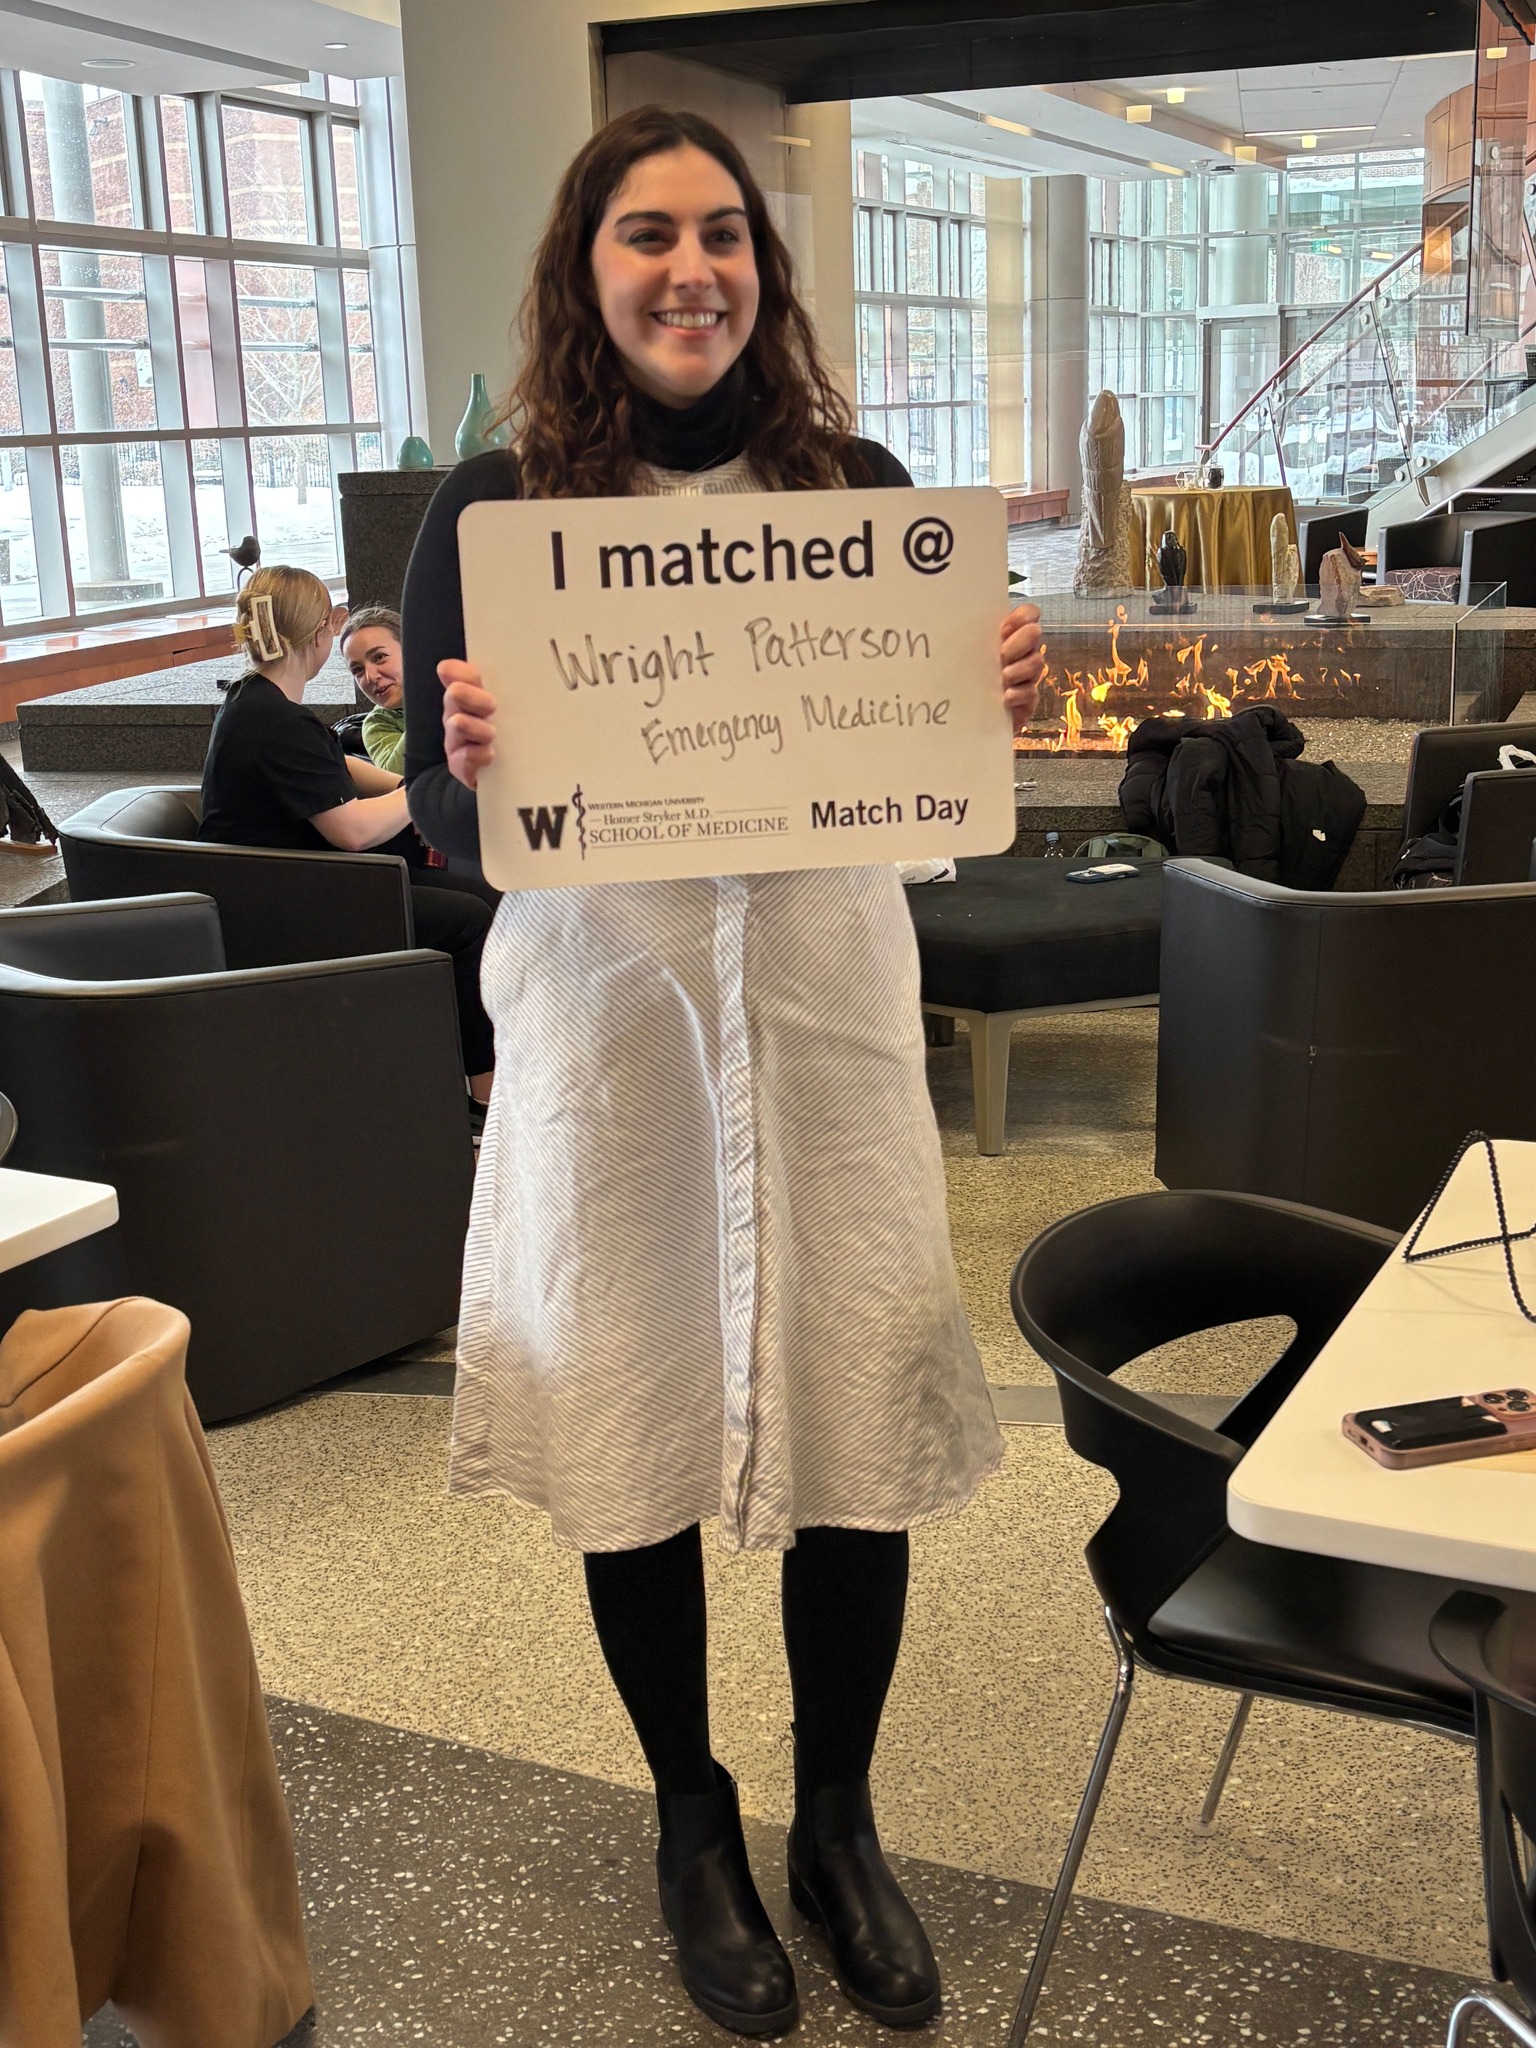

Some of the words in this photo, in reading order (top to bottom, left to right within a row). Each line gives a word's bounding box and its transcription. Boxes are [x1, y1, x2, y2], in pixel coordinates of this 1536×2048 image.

[552, 531, 566, 590] I
[599, 520, 874, 588] matched
[902, 516, 954, 575] @
[550, 630, 715, 708] Wright
[744, 617, 930, 672] Patterson
[641, 705, 784, 764] Emergency
[801, 694, 950, 733] Medicine
[517, 804, 569, 852] W
[590, 825, 664, 844] SCHOOL
[667, 823, 692, 838] OF
[697, 816, 789, 837] MEDICINE
[603, 814, 641, 826] Homer
[643, 811, 680, 826] Stryker
[684, 808, 713, 820] M.D.
[811, 797, 902, 829] Match
[915, 794, 969, 825] Day
